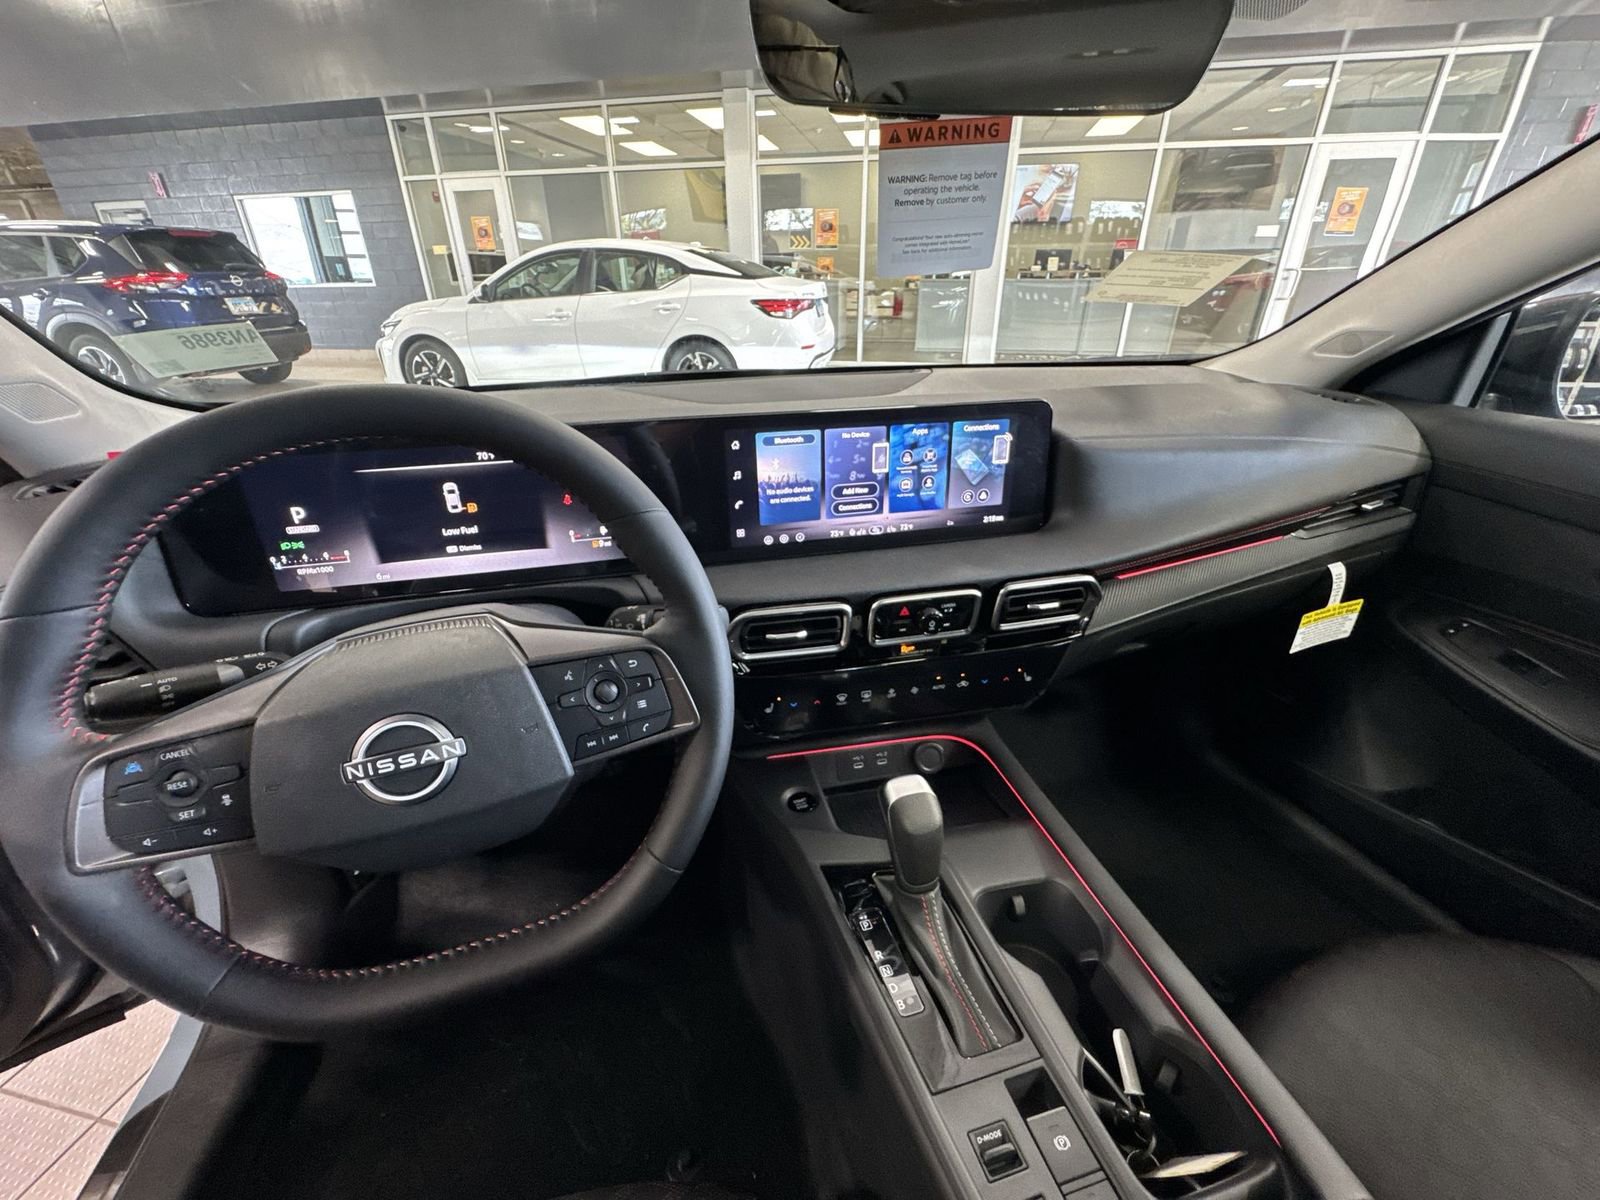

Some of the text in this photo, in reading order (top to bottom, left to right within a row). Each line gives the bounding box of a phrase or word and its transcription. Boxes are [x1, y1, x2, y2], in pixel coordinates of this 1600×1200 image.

[907, 123, 1000, 142] WARNING
[888, 171, 998, 185] WARNING: Remove tag before
[904, 184, 980, 196] operating the vehicle.
[894, 198, 924, 207] Remove
[926, 197, 934, 207] by
[936, 196, 970, 205] customer
[964, 424, 1000, 432] Connections
[780, 495, 811, 503] connected.
[839, 503, 872, 511] Connections
[290, 507, 306, 524] P
[442, 525, 478, 536] Low Fuel
[459, 544, 482, 552] Dismiss
[376, 572, 382, 580] 6
[157, 676, 178, 684] AUTO
[160, 749, 190, 760] CANCEL
[346, 741, 460, 780] NISSAN
[179, 810, 194, 820] SET
[875, 950, 884, 960] R
[889, 983, 898, 994] D
[897, 1000, 905, 1010] B
[977, 1129, 1002, 1144] D-MODE
